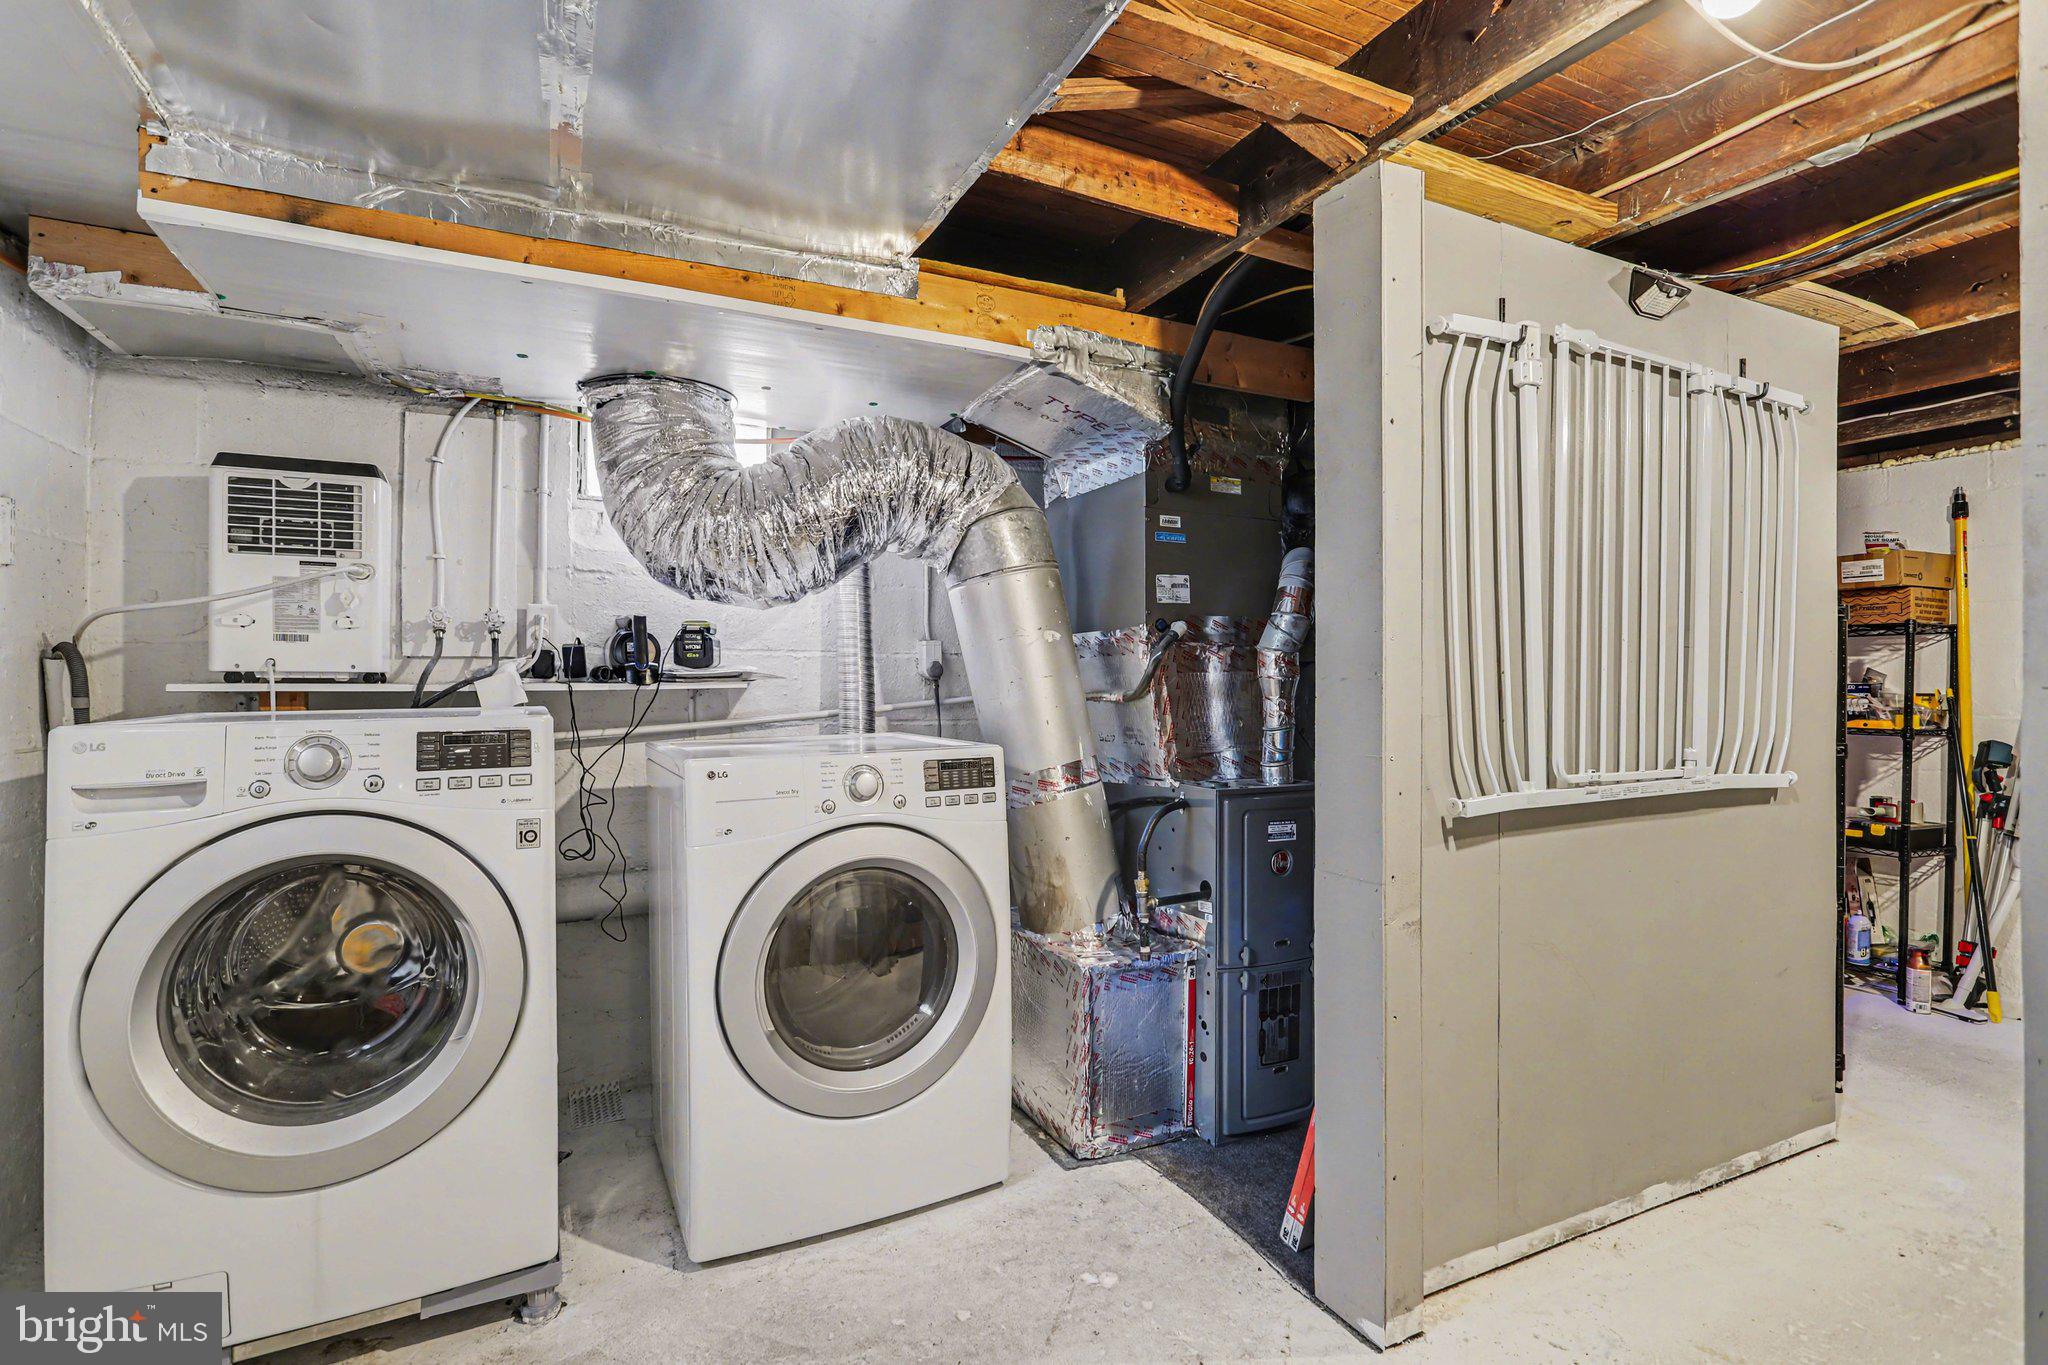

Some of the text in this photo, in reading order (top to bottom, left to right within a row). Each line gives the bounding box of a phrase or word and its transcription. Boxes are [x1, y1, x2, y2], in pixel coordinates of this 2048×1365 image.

[89, 742, 106, 752] LG
[717, 771, 729, 779] LG
[519, 829, 538, 844] 10
